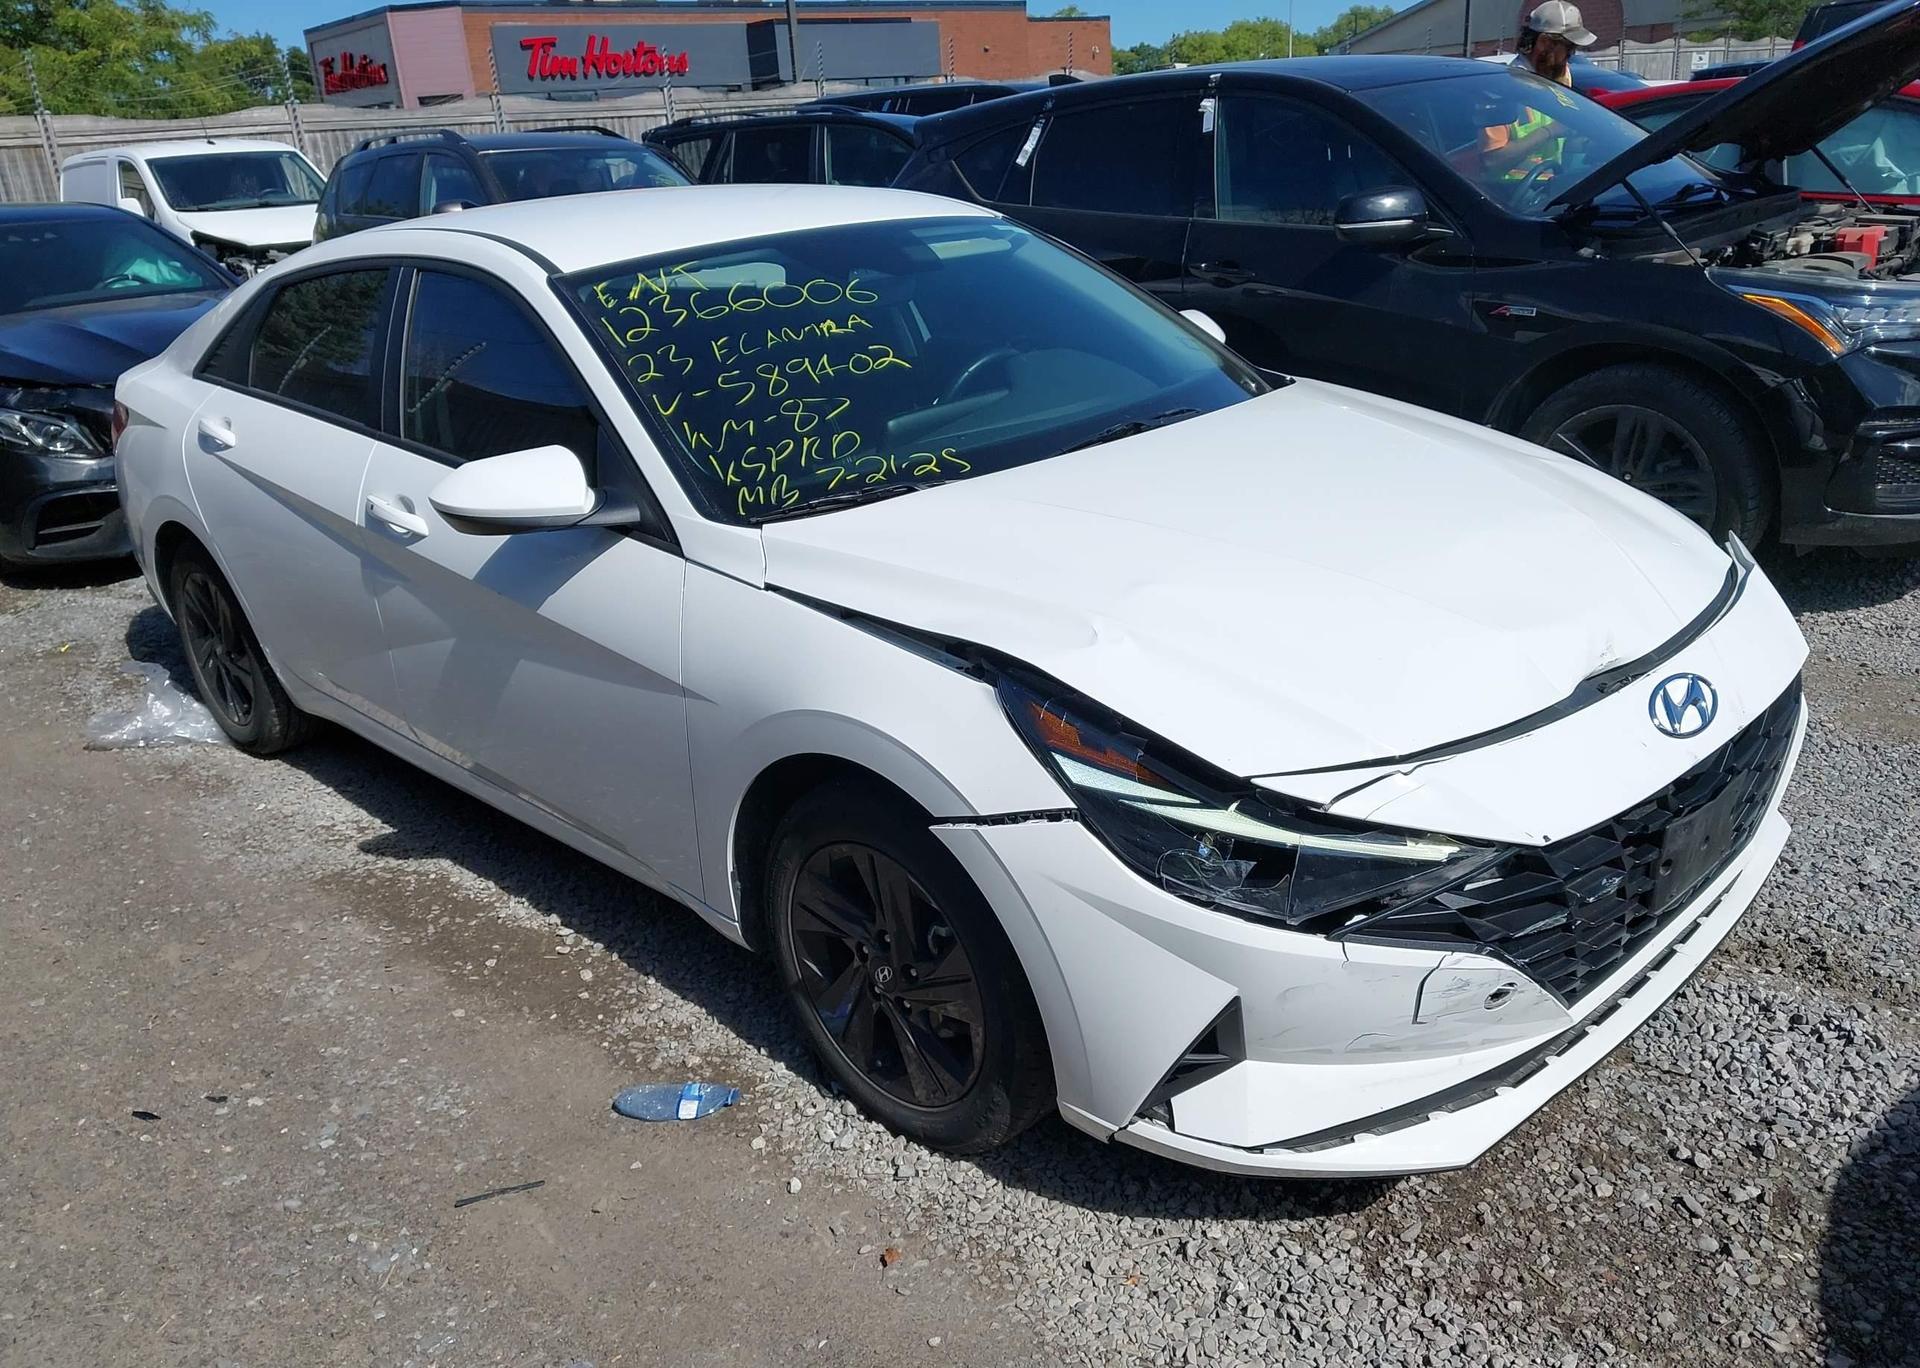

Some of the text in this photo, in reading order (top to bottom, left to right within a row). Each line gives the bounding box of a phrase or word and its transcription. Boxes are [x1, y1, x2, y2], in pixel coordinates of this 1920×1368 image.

[520, 34, 689, 80] Tim Hortons
[600, 279, 879, 349] 12366006
[627, 344, 694, 383] 23
